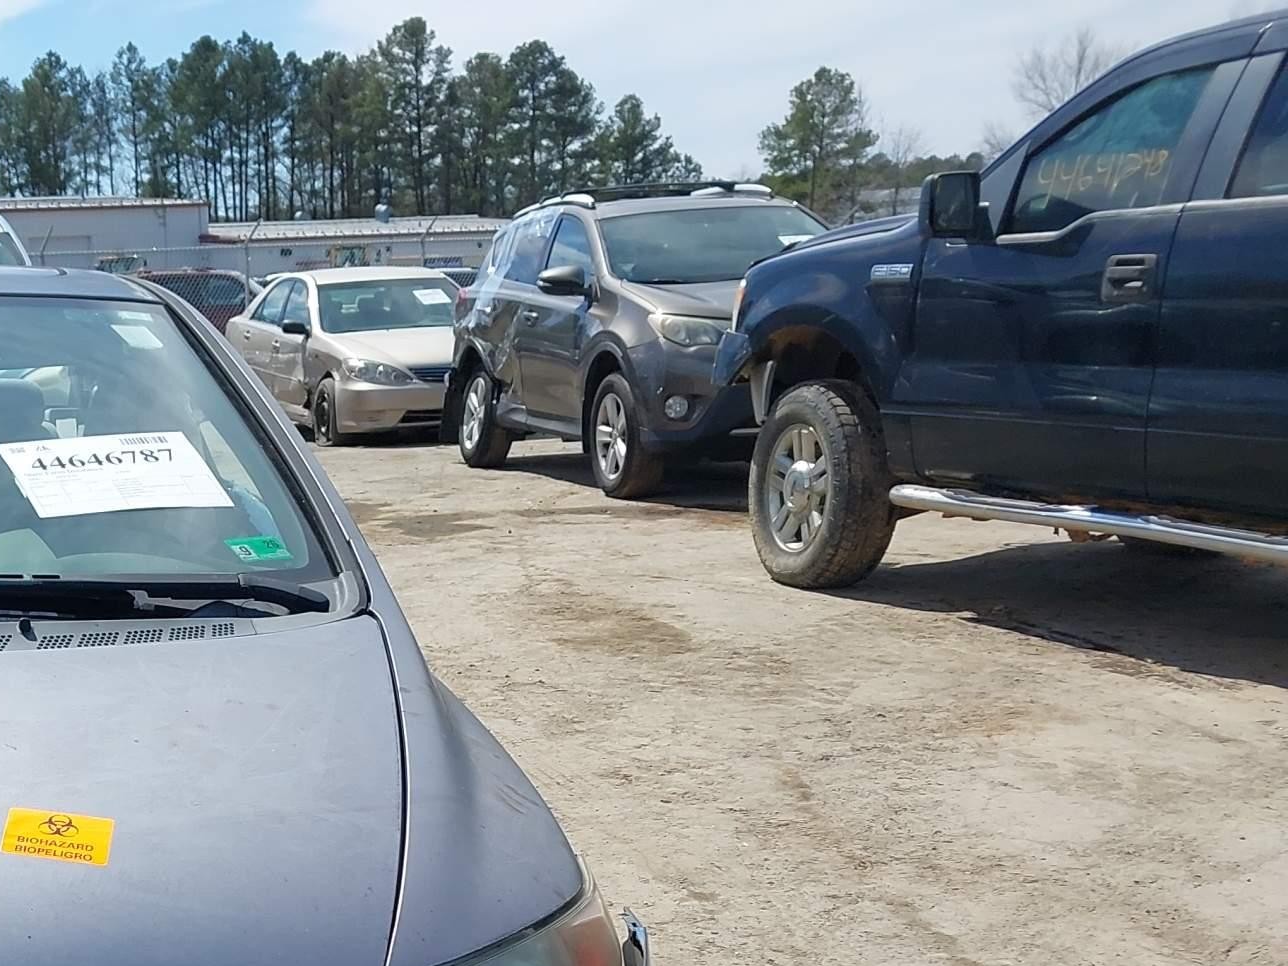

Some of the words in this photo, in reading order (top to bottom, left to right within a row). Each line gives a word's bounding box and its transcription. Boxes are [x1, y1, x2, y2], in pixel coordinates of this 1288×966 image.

[31, 448, 173, 471] 44646787
[16, 835, 95, 852] BIOHAZARD
[14, 844, 93, 861] BIOPELIGRO
